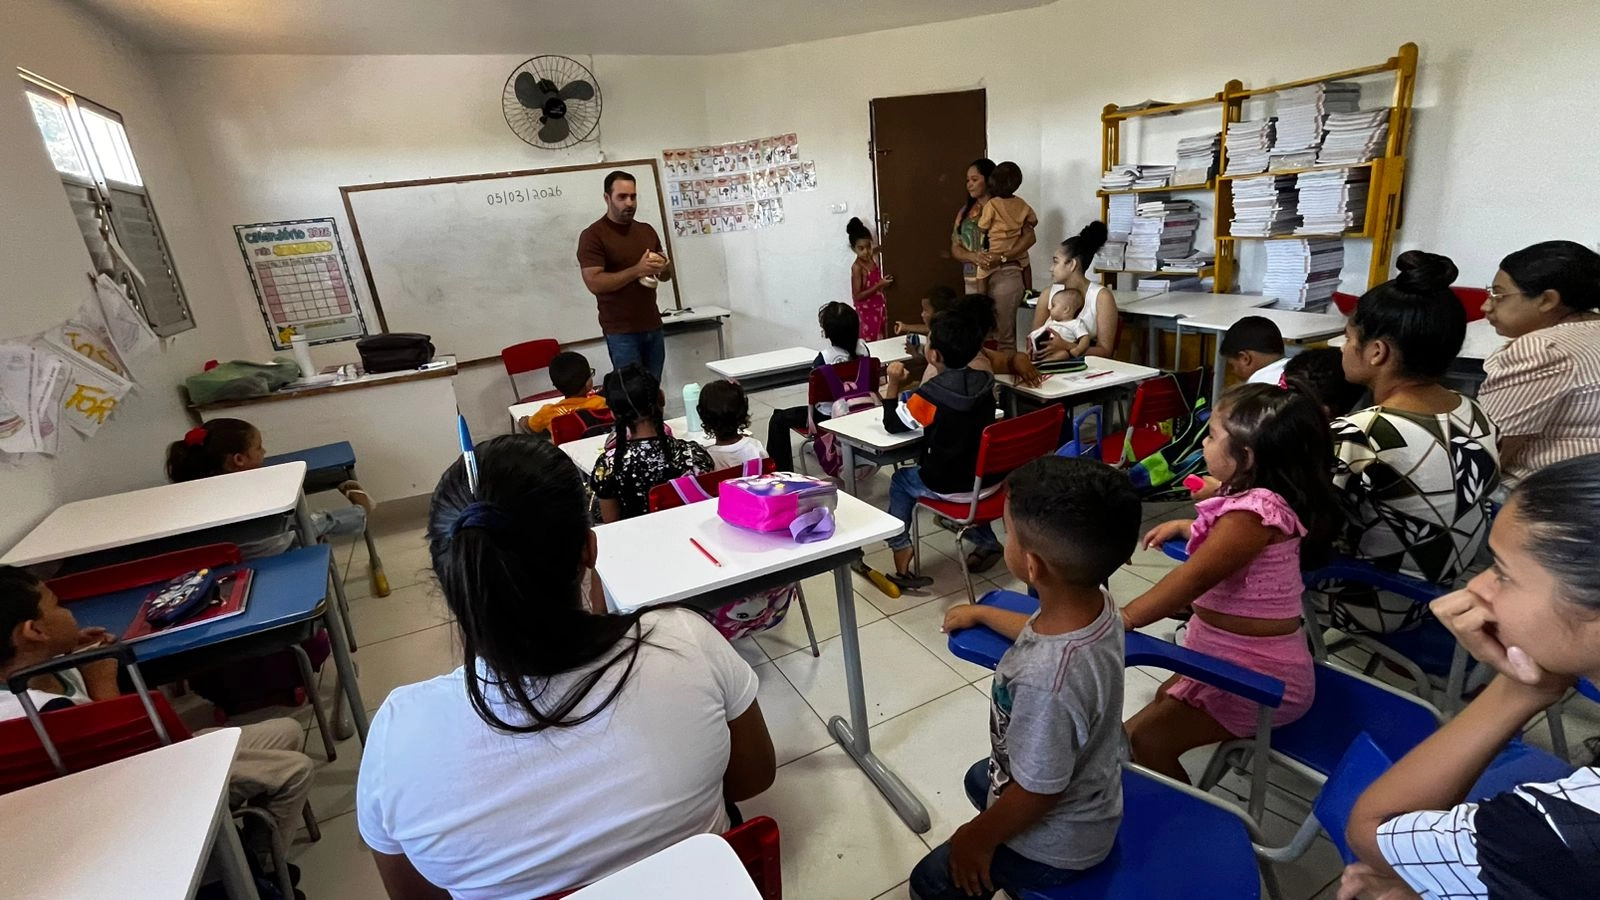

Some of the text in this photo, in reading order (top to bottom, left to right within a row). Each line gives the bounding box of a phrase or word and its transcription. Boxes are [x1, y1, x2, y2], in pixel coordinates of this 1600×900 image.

[671, 196, 679, 206] H
[710, 217, 717, 226] U
[721, 216, 729, 225] V
